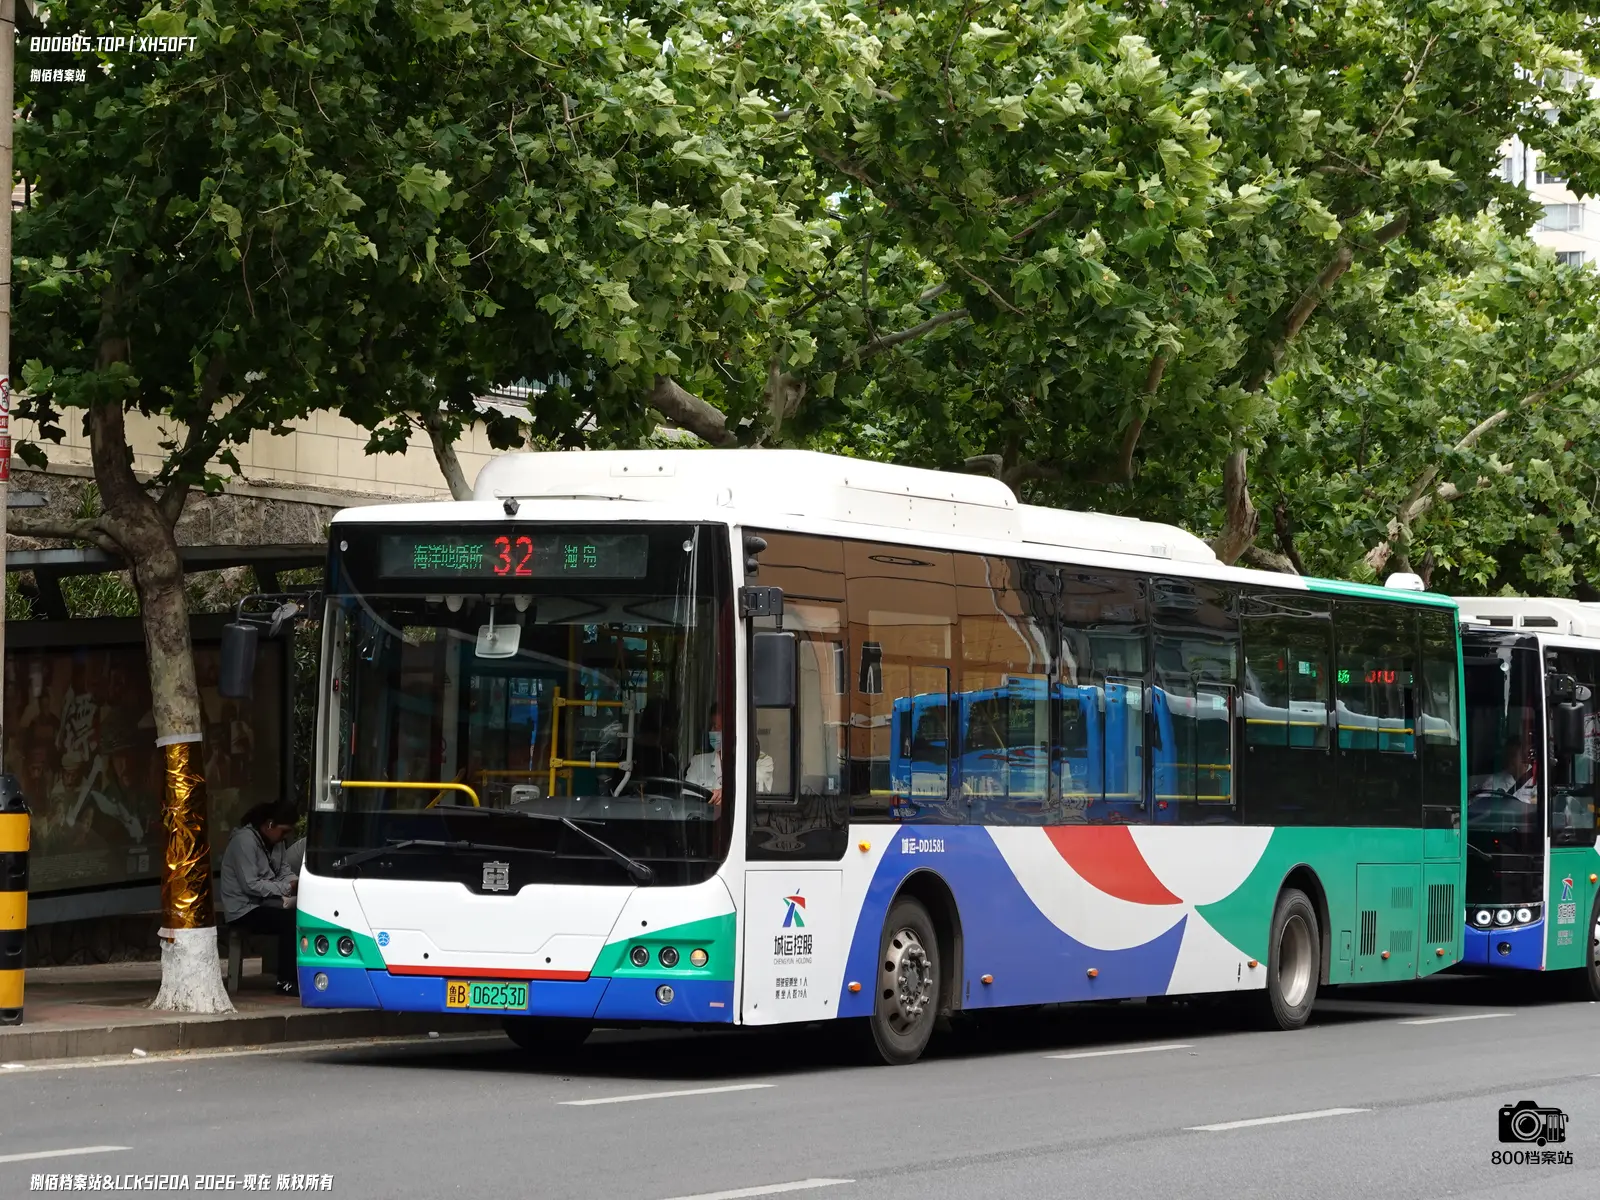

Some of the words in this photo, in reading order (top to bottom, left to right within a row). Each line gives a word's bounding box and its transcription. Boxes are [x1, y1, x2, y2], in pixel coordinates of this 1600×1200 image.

[413, 544, 484, 570] 海洋地质所
[493, 536, 534, 577] 32
[901, 838, 945, 855] 城运-DD1581
[774, 934, 813, 956] 城运控股
